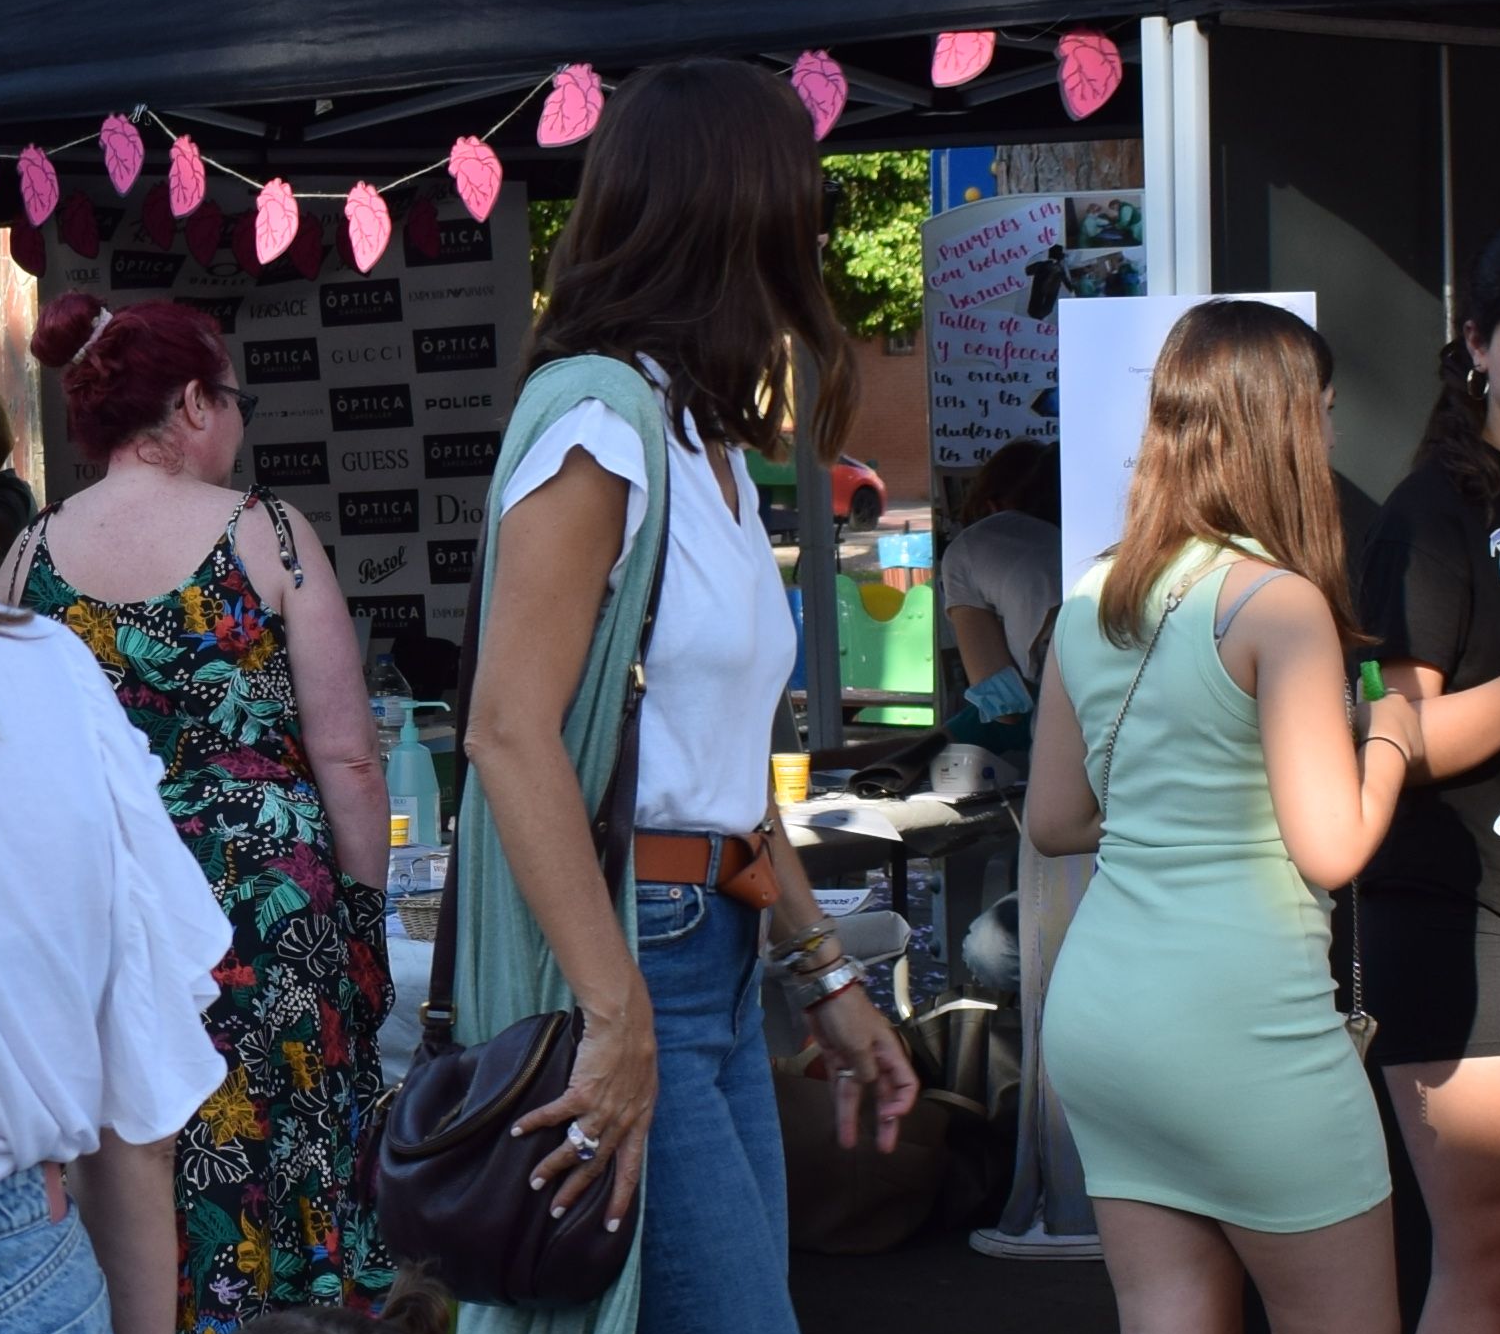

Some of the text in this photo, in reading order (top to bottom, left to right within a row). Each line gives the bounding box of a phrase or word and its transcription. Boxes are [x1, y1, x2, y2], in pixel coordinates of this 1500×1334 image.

[439, 229, 484, 245] TICA
[931, 227, 1058, 288] con bolsas de
[950, 275, 1025, 309] basura
[250, 299, 308, 318] VERSACE
[939, 311, 988, 334] Taller
[999, 316, 1023, 335] de
[331, 346, 402, 364] GUCCI
[936, 340, 949, 364] y
[1046, 367, 1059, 383] d
[425, 395, 493, 410] POLICE
[977, 399, 990, 417] y
[999, 390, 1024, 406] los
[342, 449, 409, 472] GUESS
[939, 446, 962, 462] tos
[435, 494, 483, 525] Dio
[358, 546, 408, 584] Persol
